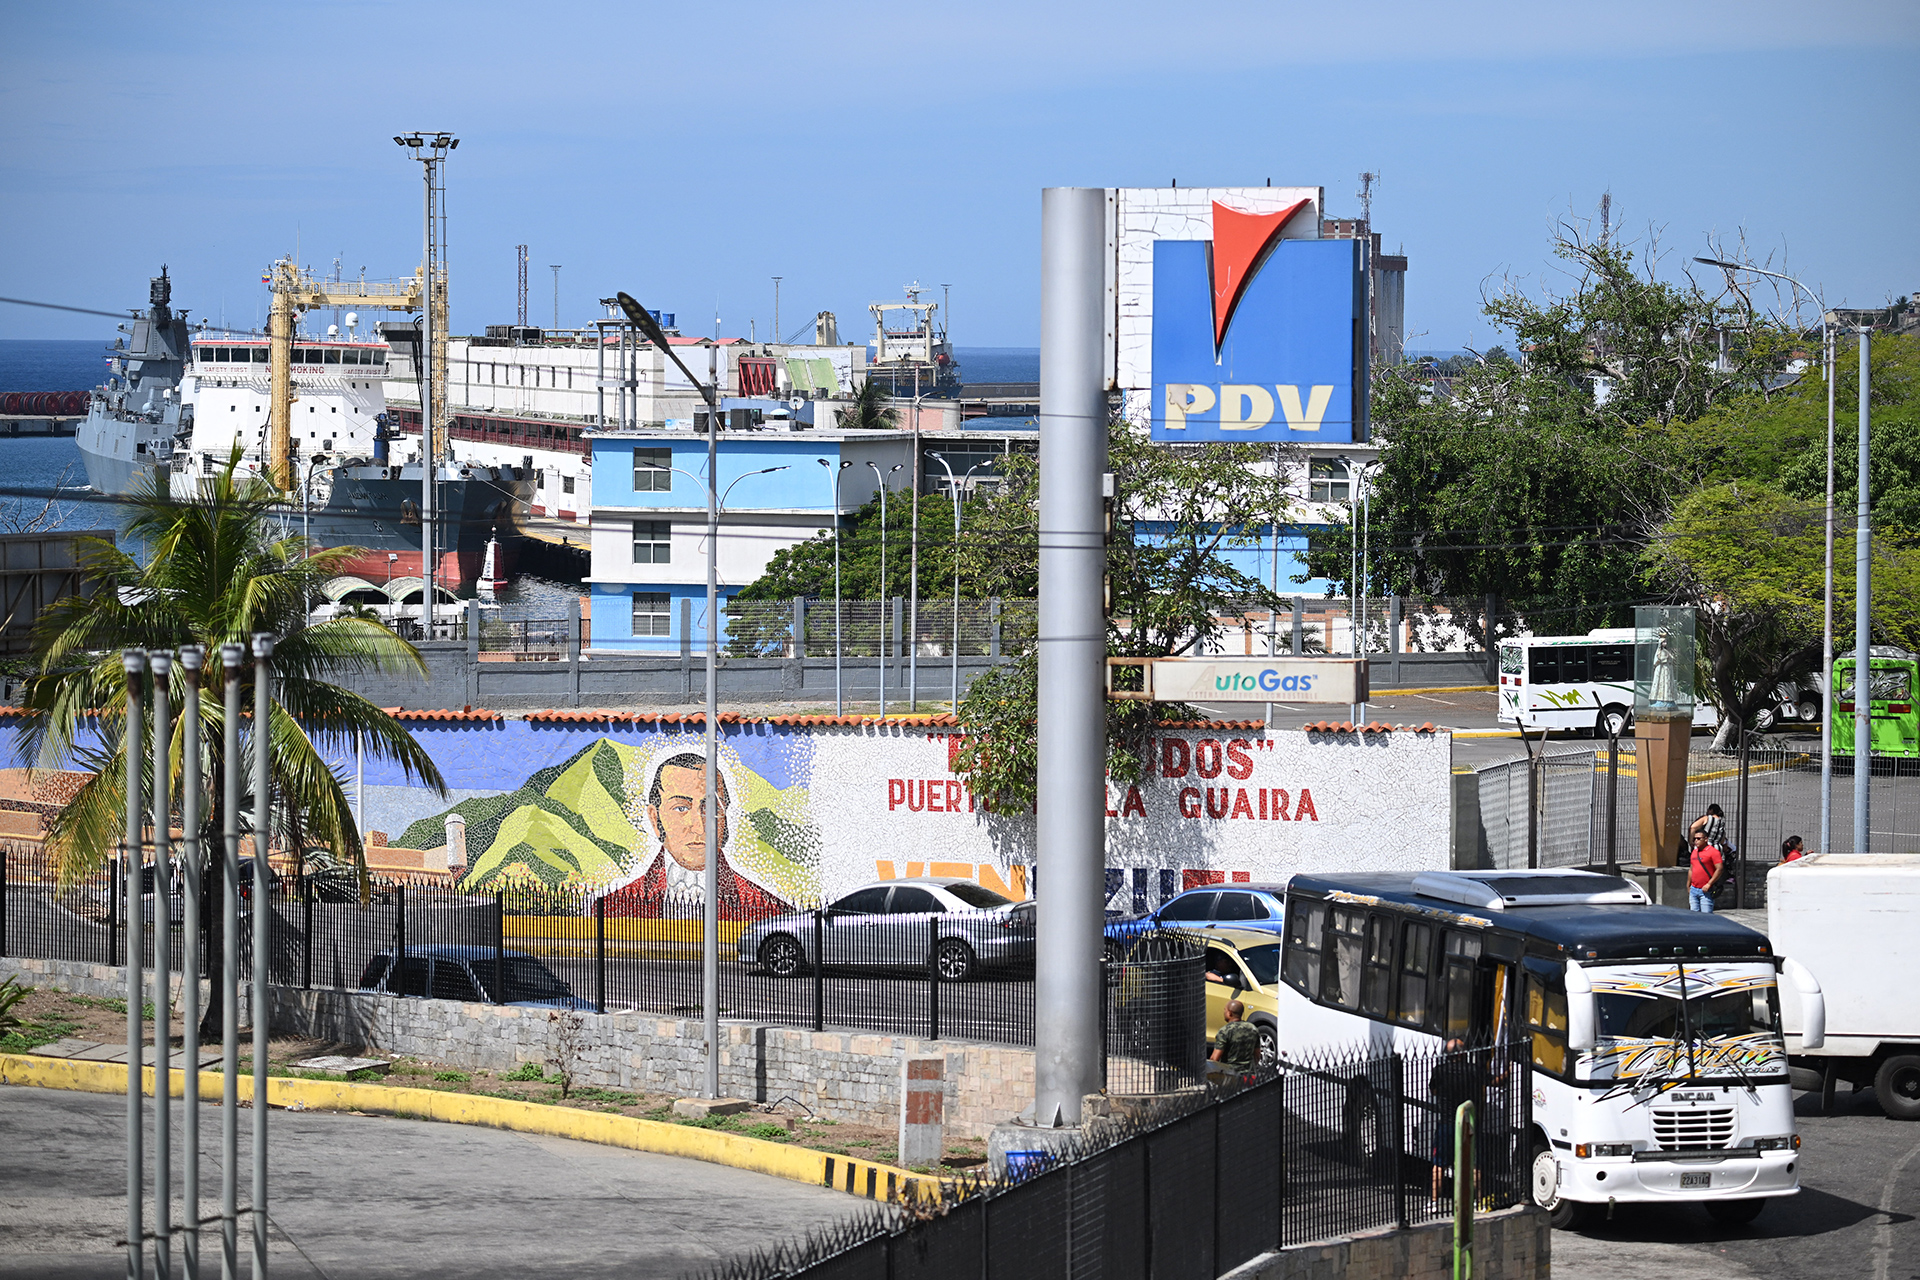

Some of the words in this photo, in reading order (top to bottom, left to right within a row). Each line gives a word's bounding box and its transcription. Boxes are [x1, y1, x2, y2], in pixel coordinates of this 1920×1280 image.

[290, 365, 325, 374] MOKING
[1165, 384, 1334, 431] PDV
[1179, 787, 1319, 821] GUAIRA
[1671, 1092, 1715, 1102] ENCAVA
